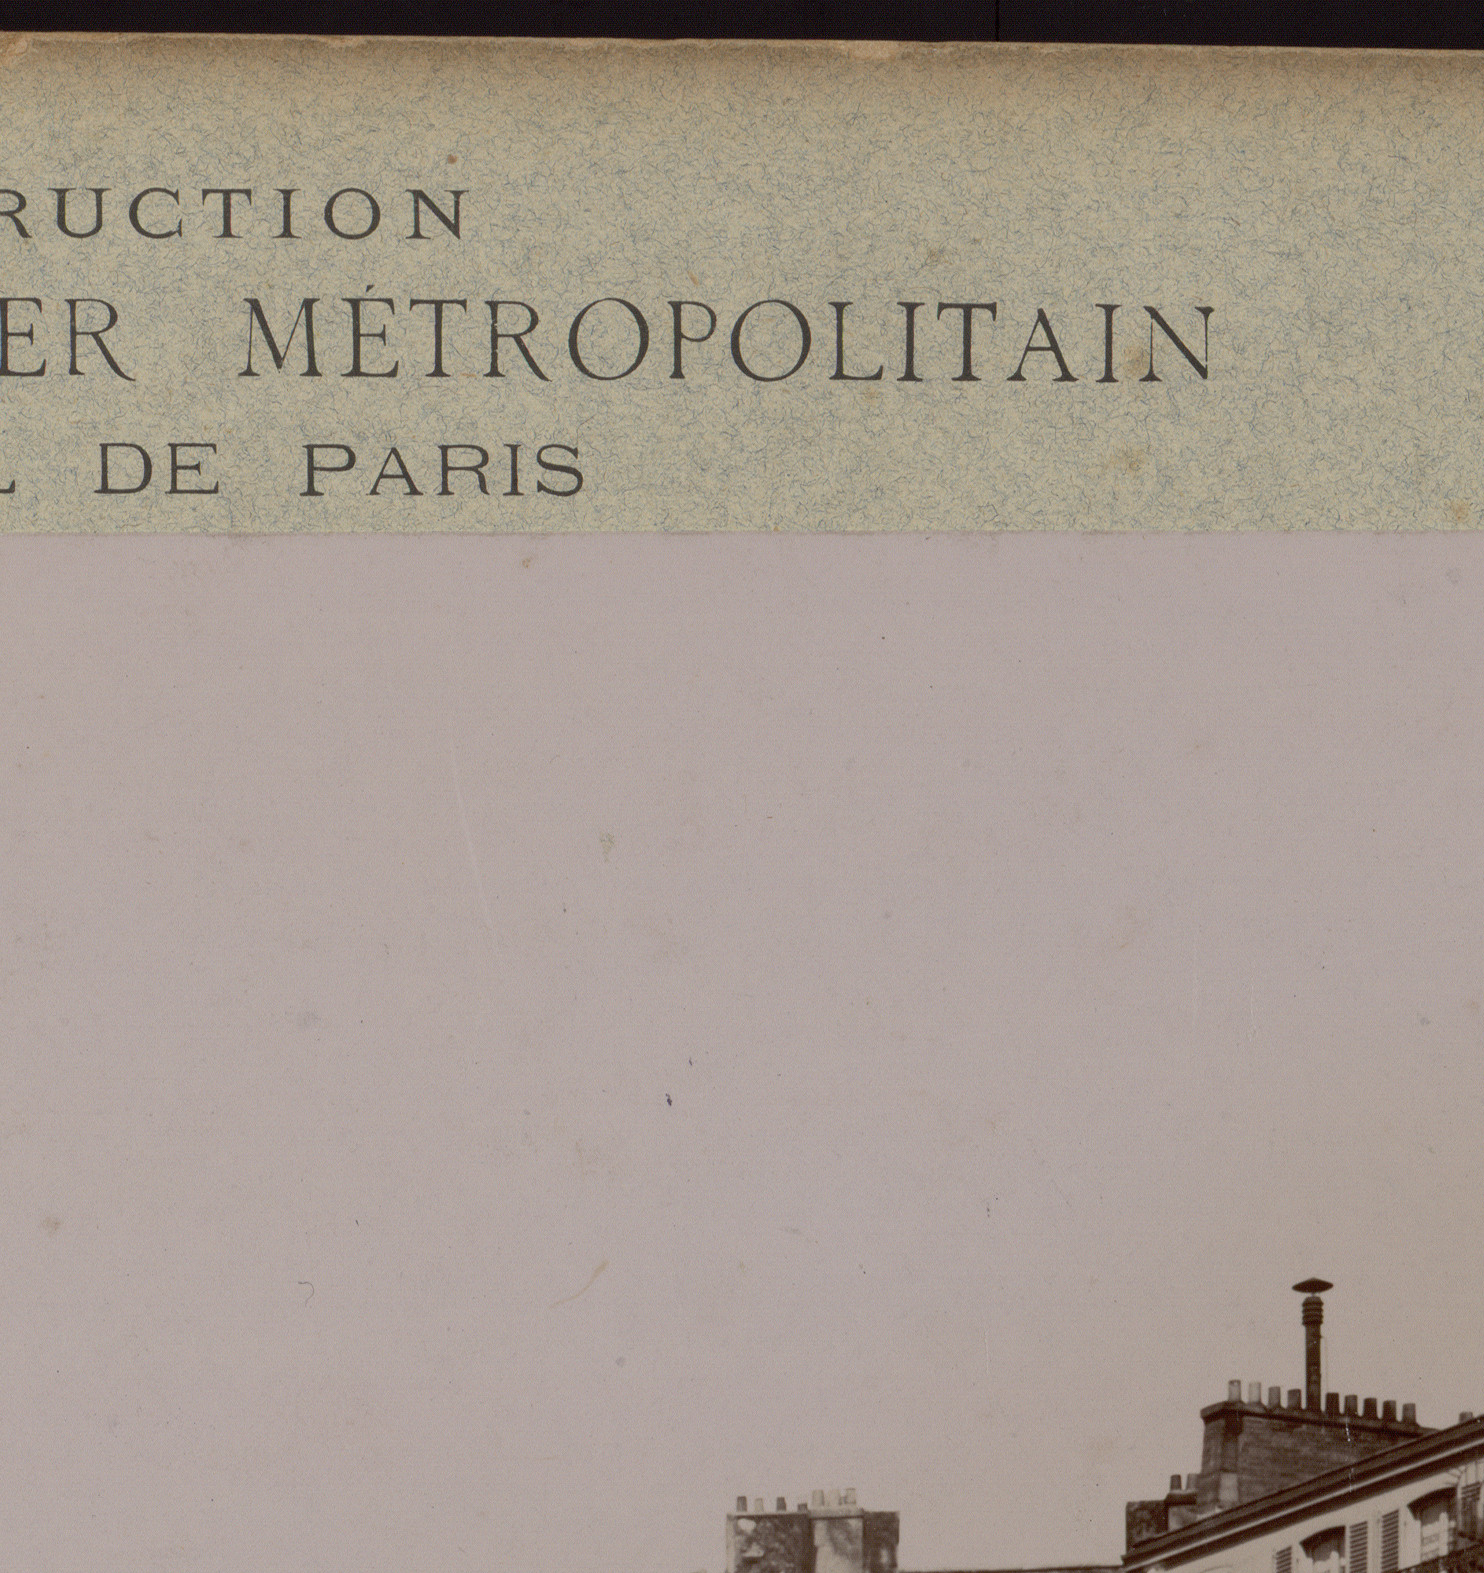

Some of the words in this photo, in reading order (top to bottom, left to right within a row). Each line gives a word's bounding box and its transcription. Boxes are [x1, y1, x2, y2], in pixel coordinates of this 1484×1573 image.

[238, 284, 1215, 385] MÉTROPOLITAIN
[94, 441, 220, 496] DE
[300, 443, 585, 498] PARIS
